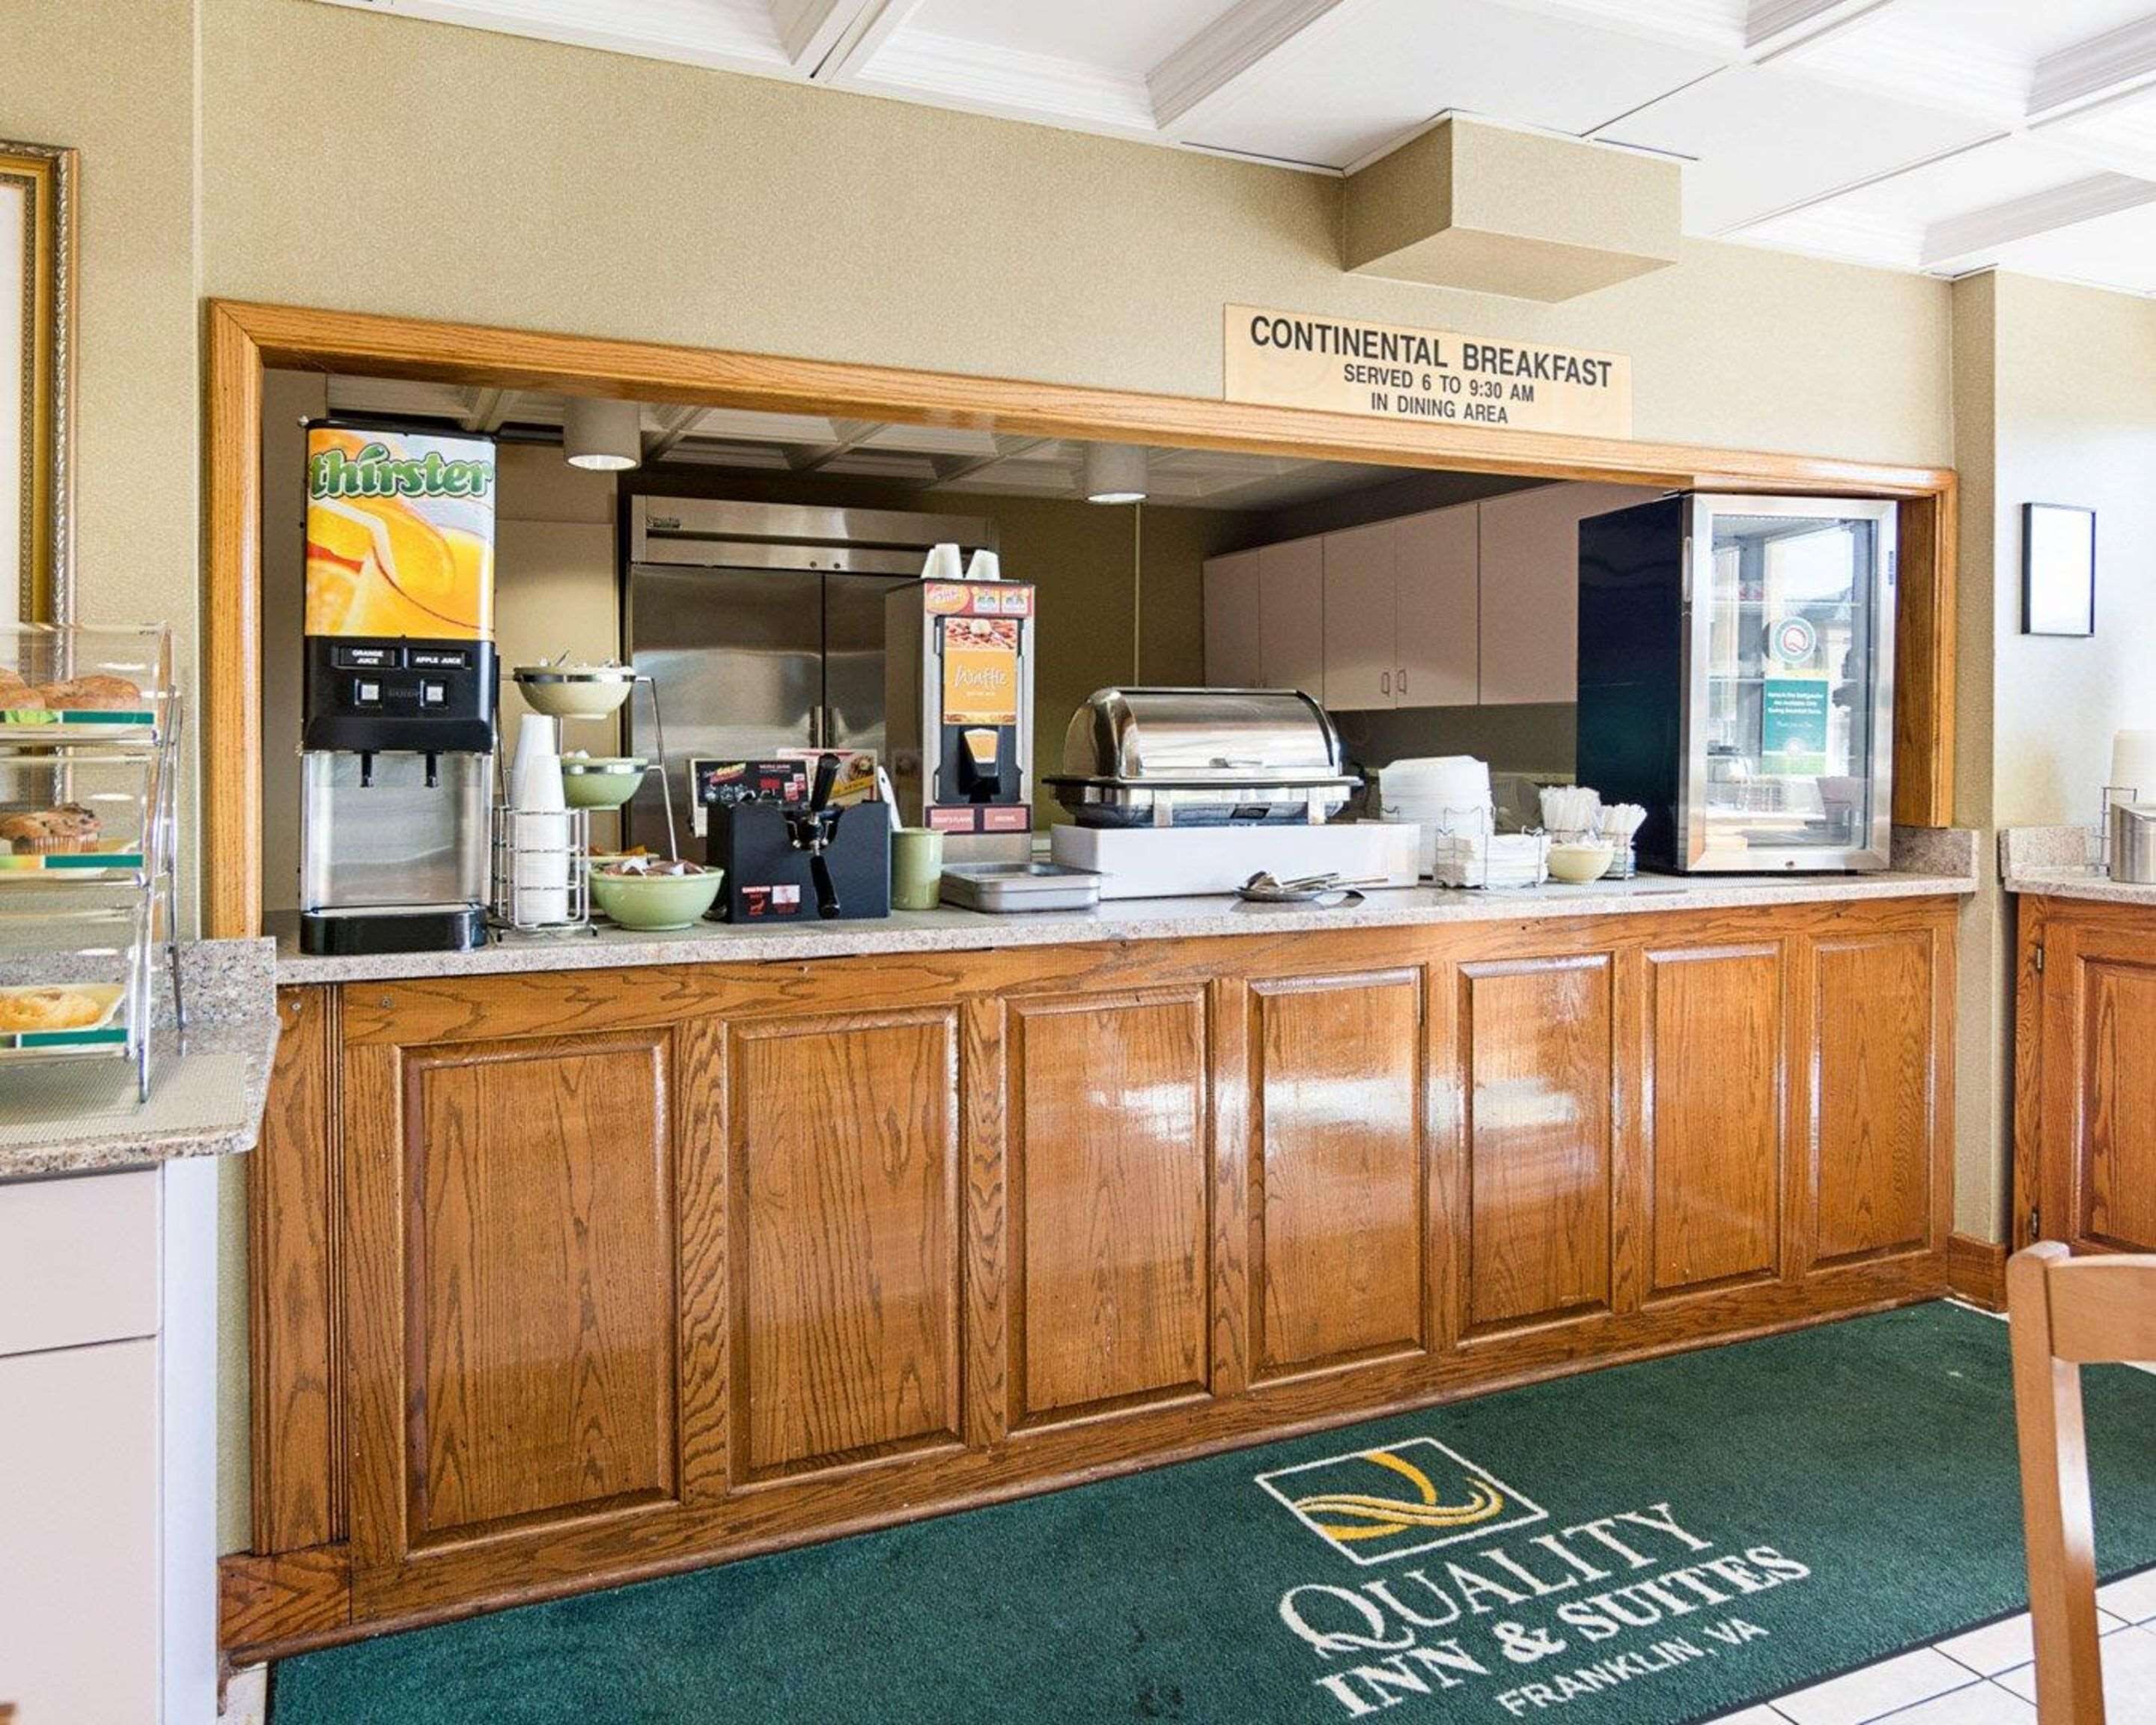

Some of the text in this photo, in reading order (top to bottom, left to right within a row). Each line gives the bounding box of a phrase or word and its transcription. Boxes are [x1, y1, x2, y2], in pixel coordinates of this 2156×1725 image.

[1250, 315, 1613, 388] CONTINENTAL BREAKFAST
[1344, 363, 1534, 402] SERVED 6 TO 9:30 AM
[1371, 392, 1508, 423] IN DINING AREA
[309, 443, 495, 500] thirster
[351, 649, 384, 657] ORANGE
[415, 656, 439, 664] APPLE
[1279, 1502, 1714, 1660] QUALITY
[1315, 1545, 1812, 1719] INN & SUITES
[1495, 1617, 1770, 1718] FRANKLIN, VA
